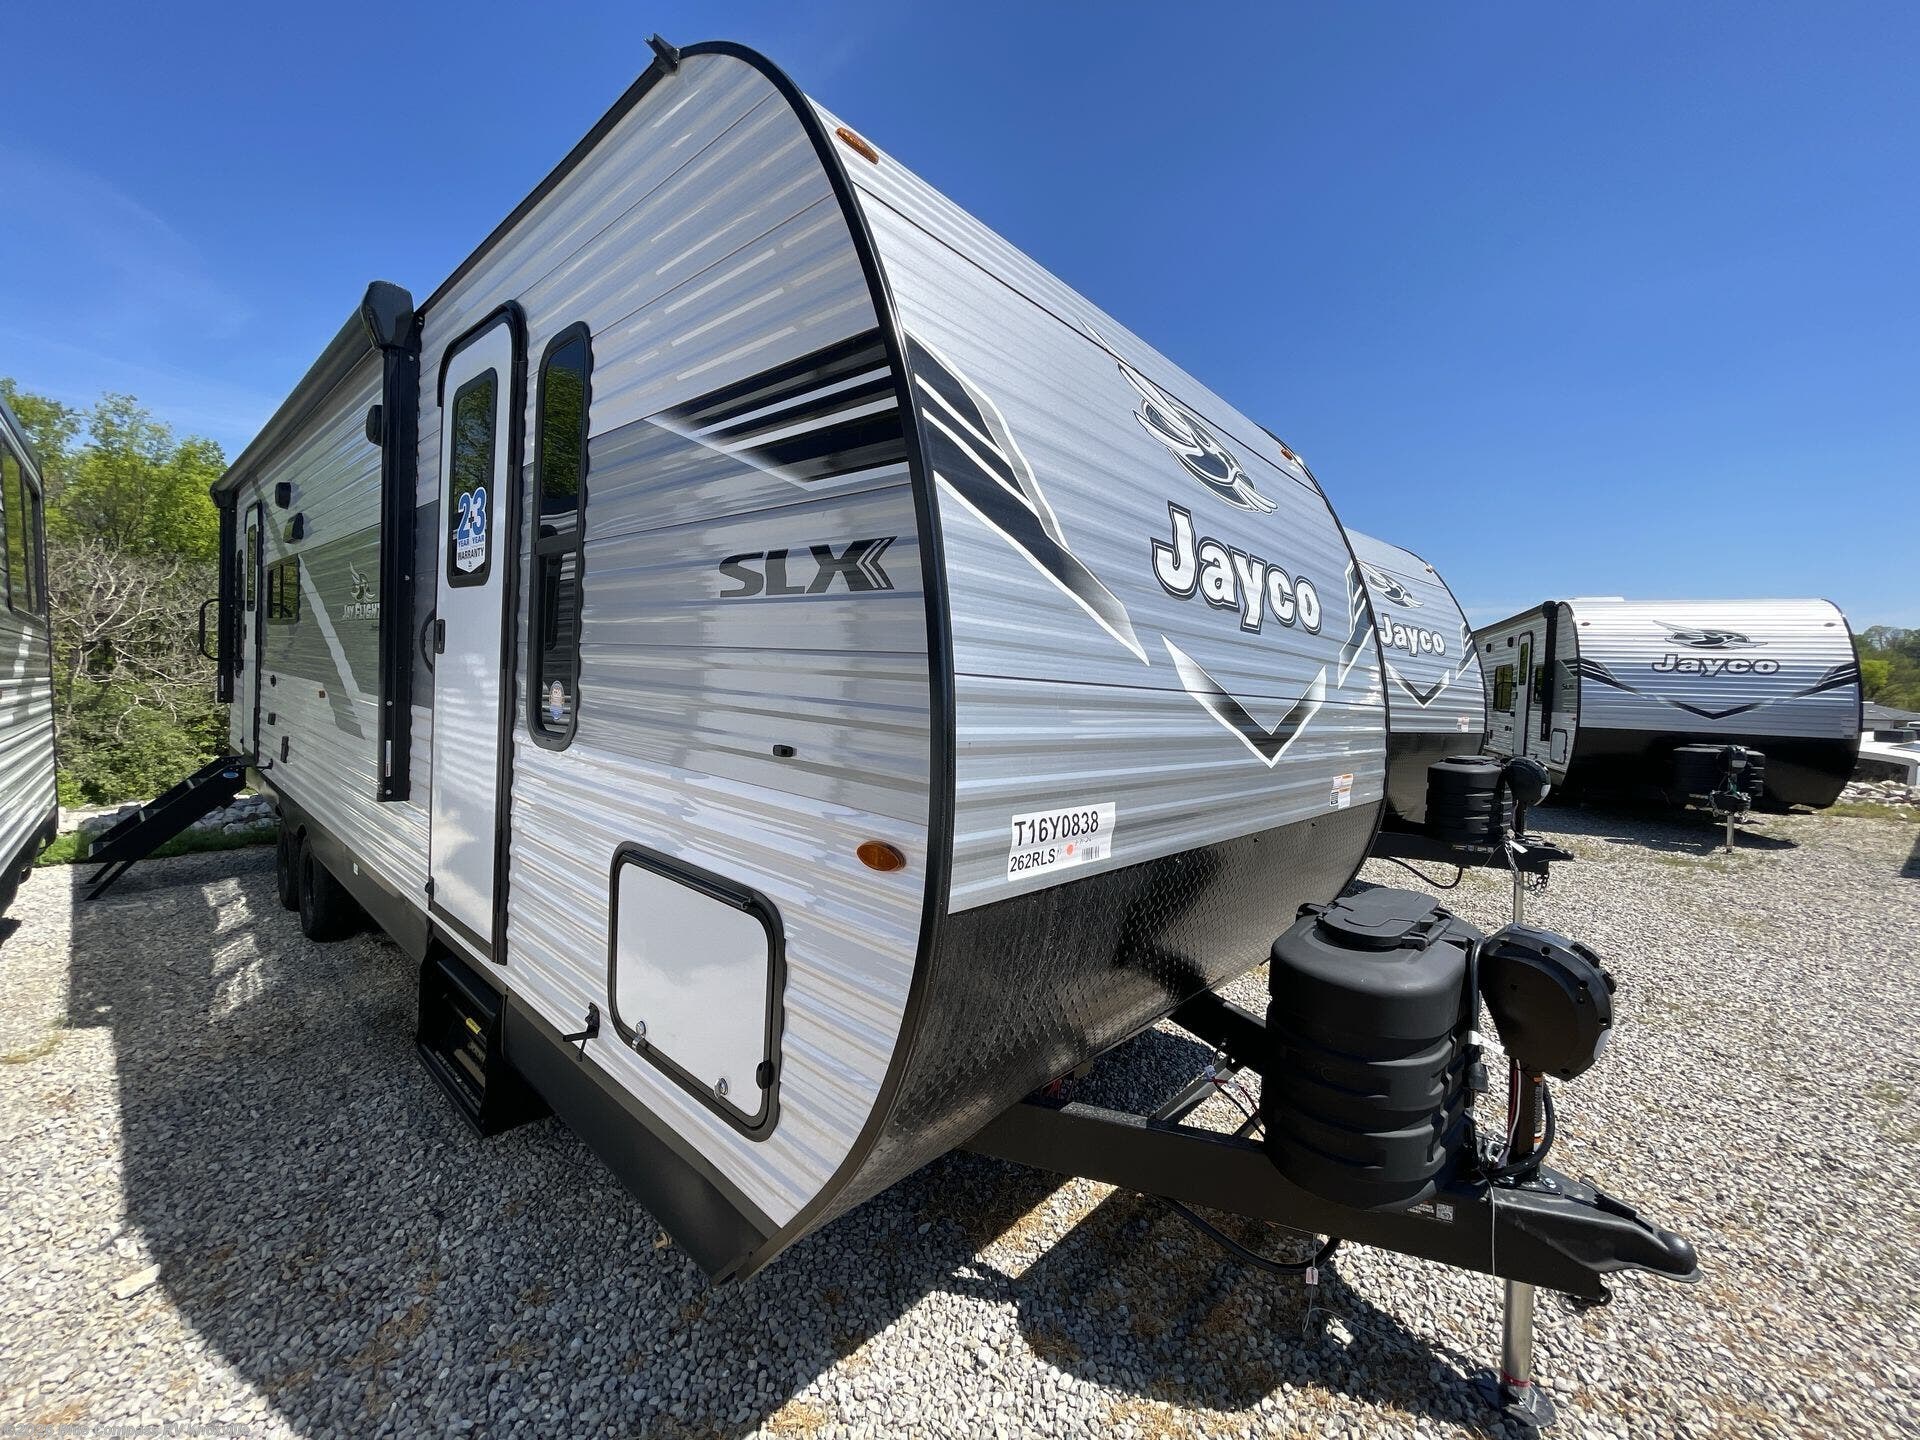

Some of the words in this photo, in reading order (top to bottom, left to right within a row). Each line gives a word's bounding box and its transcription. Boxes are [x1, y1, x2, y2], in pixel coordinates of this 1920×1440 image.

[457, 547, 485, 561] WARRANTY
[472, 535, 485, 545] YEAR
[718, 536, 898, 598] SLX
[1150, 500, 1322, 635] Jayco
[1377, 612, 1446, 657] Jayco
[1651, 653, 1780, 677] Jayco
[1014, 810, 1099, 846] T16Y0838
[1009, 848, 1056, 873] 262RLS
